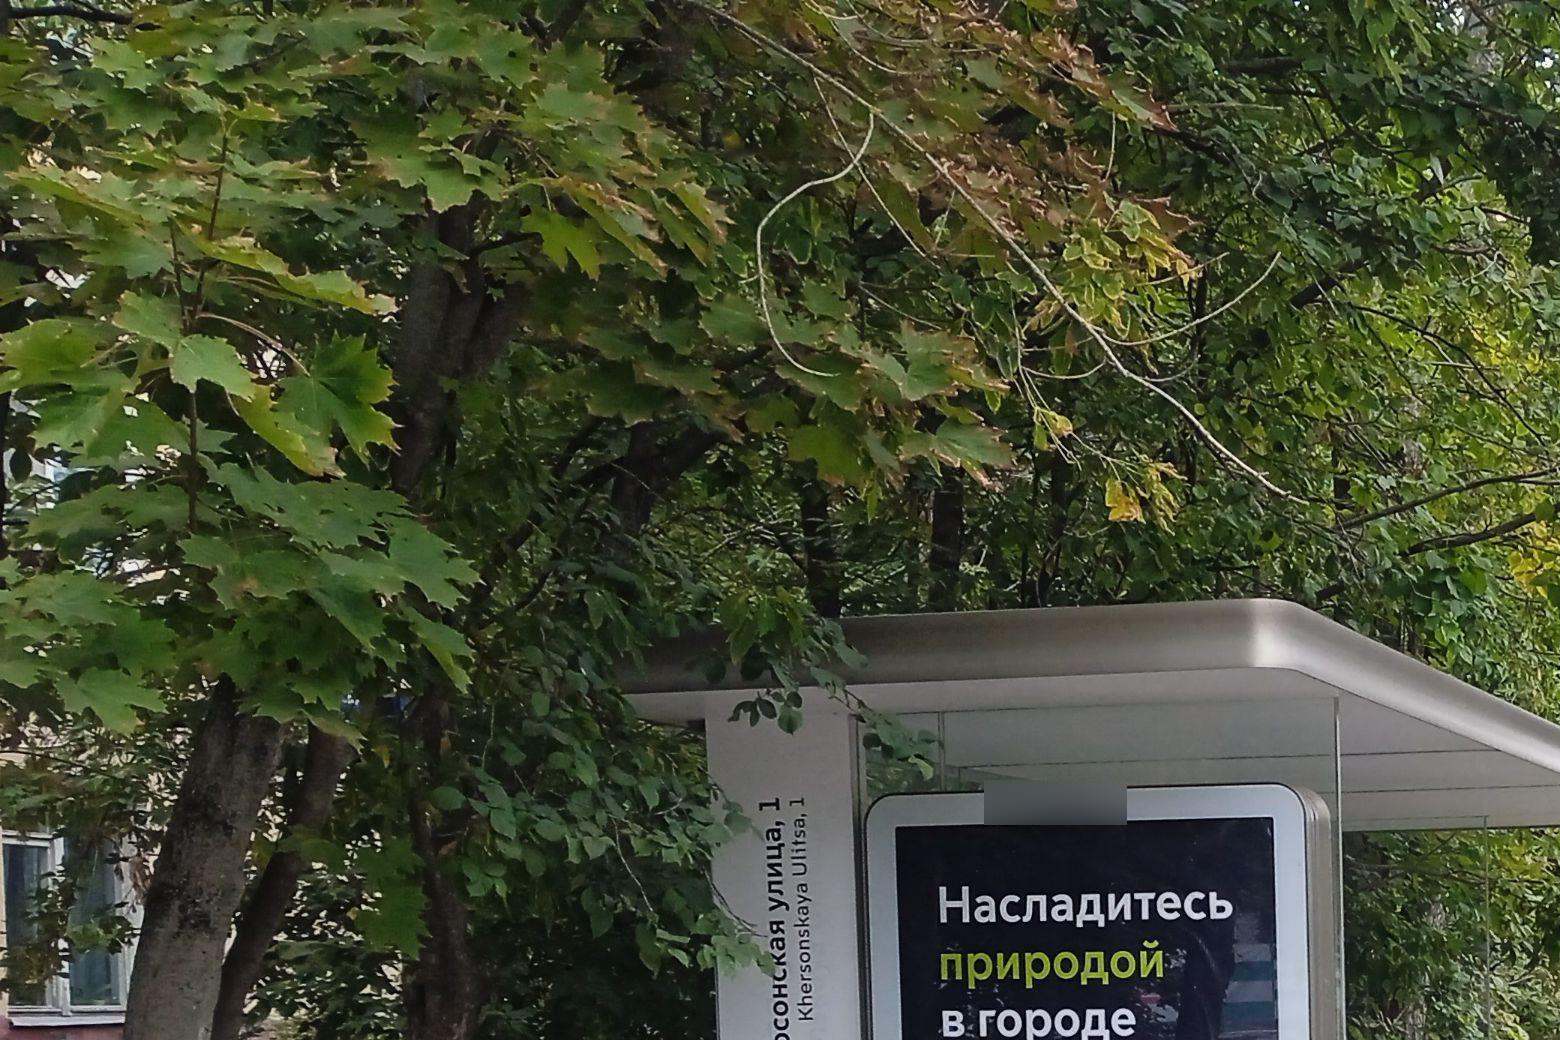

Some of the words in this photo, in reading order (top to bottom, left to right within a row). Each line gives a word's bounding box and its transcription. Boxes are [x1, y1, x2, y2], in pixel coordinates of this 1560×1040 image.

[758, 797, 780, 812] 1
[789, 797, 806, 807] 1
[764, 819, 790, 912] улица,
[790, 813, 808, 877] Ulitsa,
[938, 886, 1234, 928] Насладитесь
[793, 881, 814, 1021] Khersonskaya
[940, 939, 1165, 990] природой
[941, 1009, 966, 1038] в
